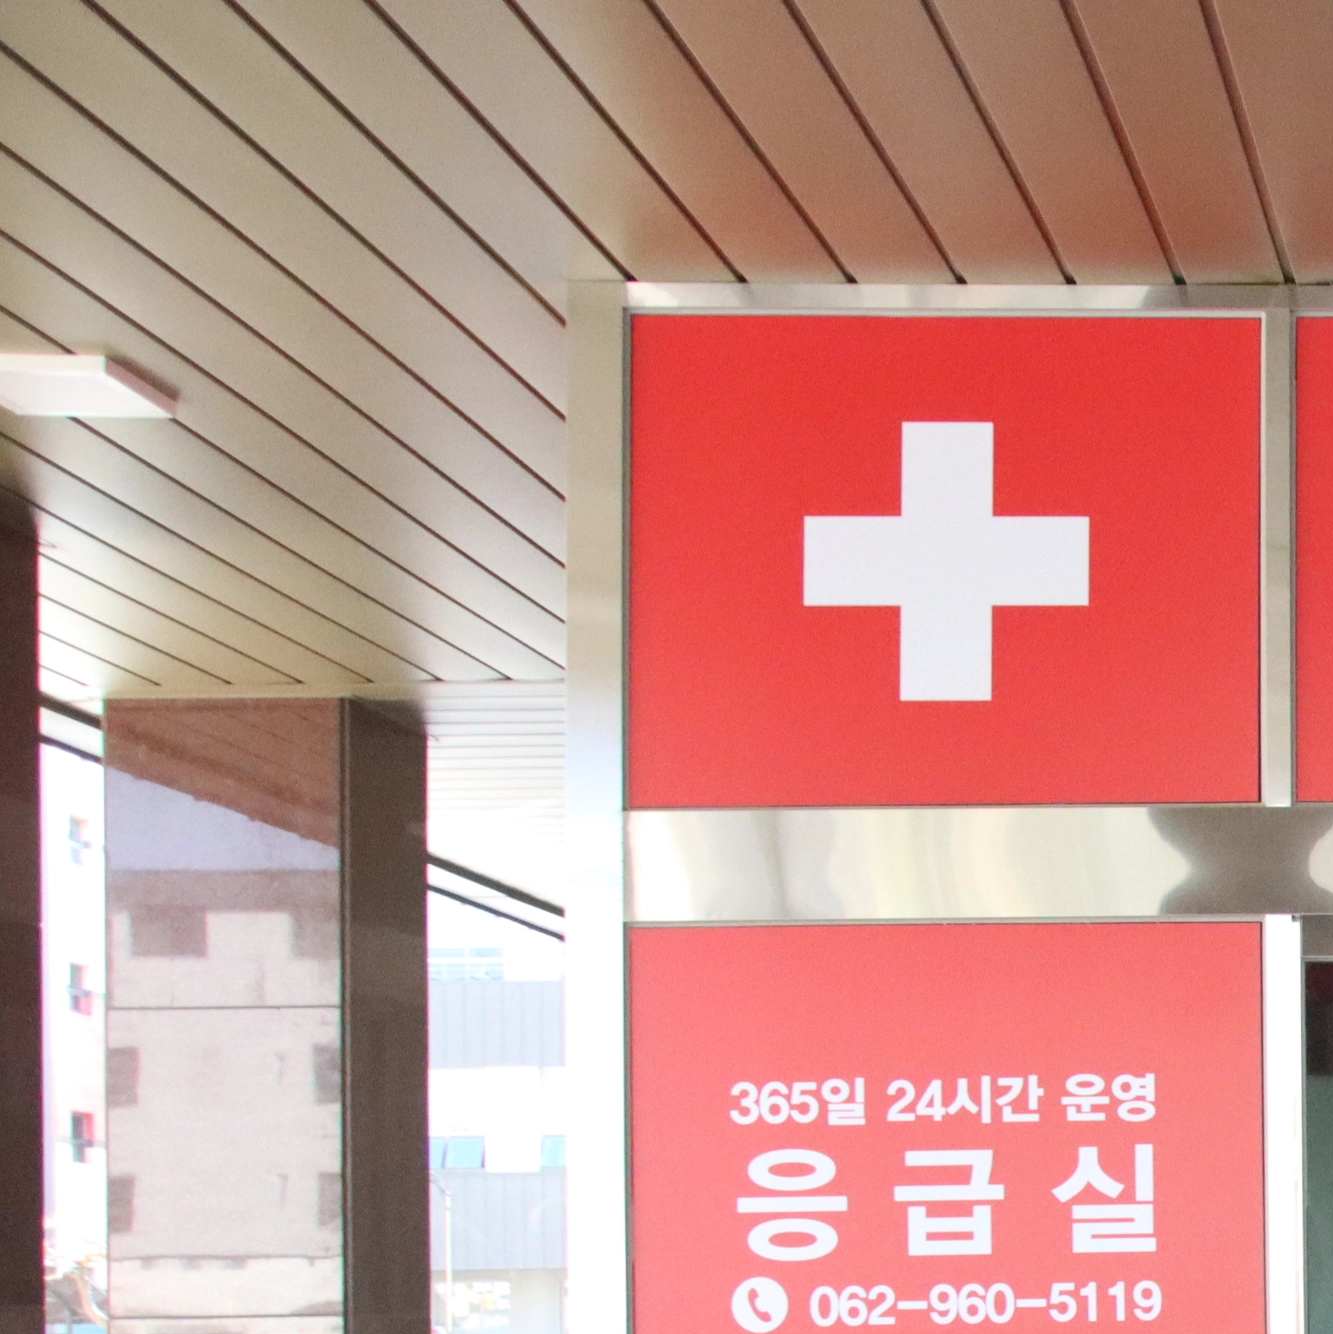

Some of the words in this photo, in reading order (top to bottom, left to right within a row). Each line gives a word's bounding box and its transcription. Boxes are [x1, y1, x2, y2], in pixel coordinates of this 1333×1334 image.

[729, 1076, 867, 1127] 365일
[886, 1073, 1044, 1124] 24시간
[1060, 1071, 1158, 1122] 운영
[809, 1279, 1164, 1328] 062-960-5119
